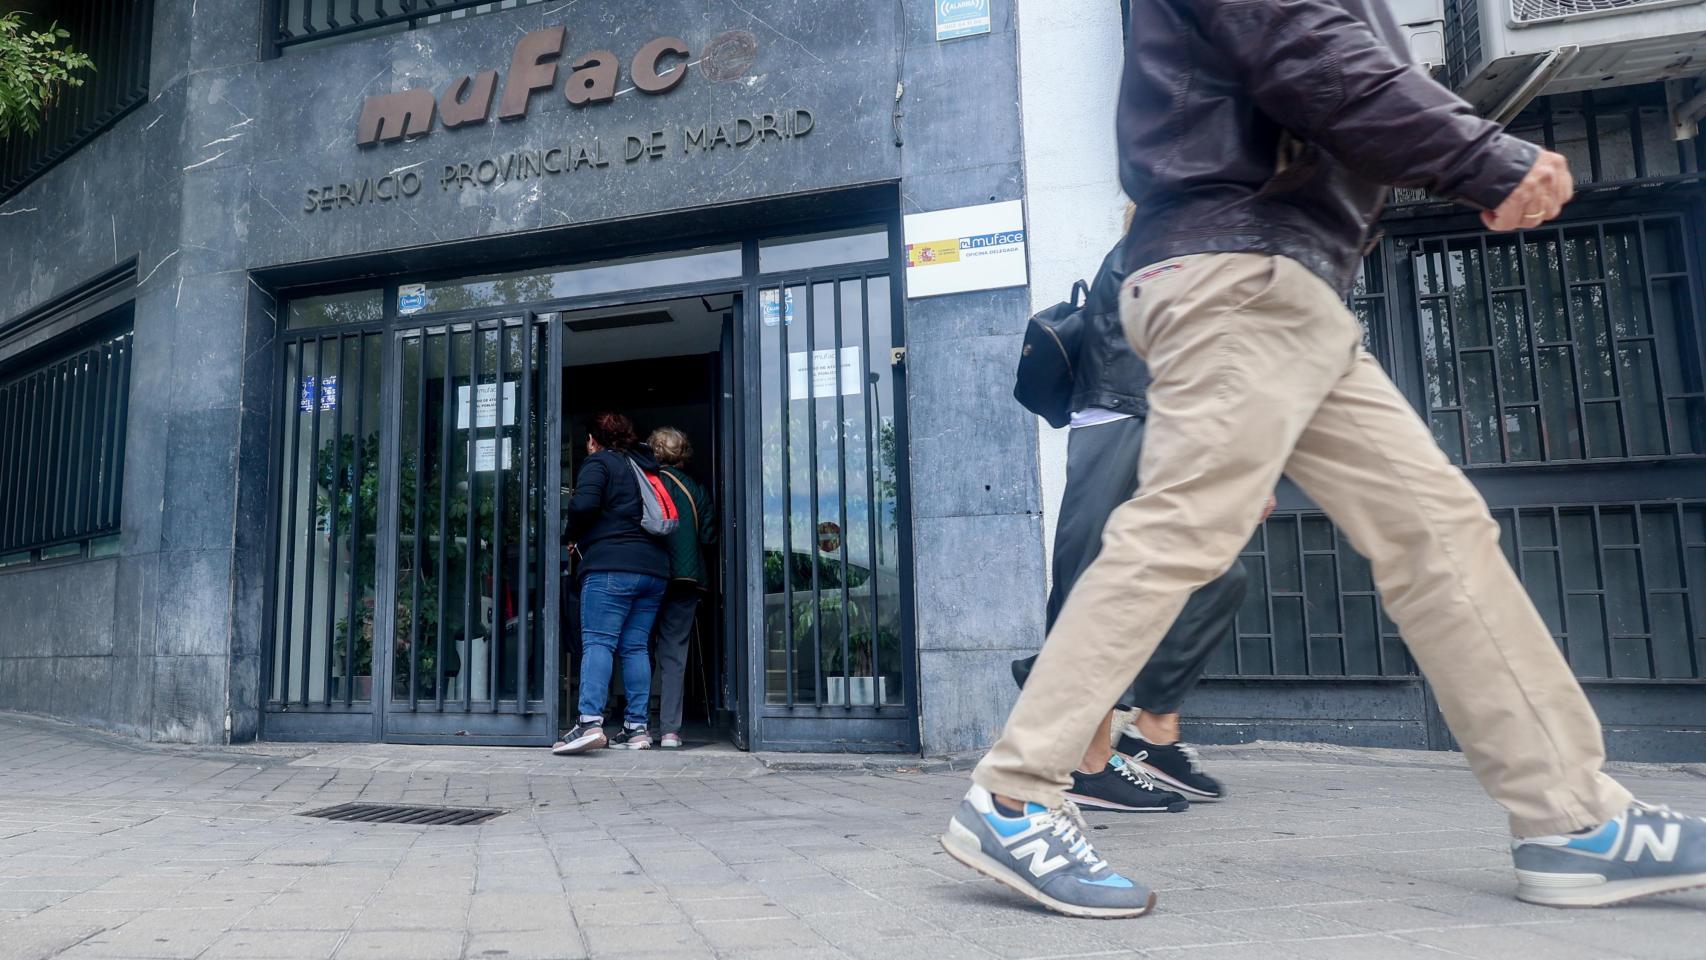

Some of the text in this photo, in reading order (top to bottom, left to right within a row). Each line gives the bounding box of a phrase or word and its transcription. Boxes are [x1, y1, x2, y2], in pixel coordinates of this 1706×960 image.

[304, 109, 816, 213] SERVICIO PROVINCIAL DE MADRID
[972, 233, 1023, 247] muface
[1010, 838, 1069, 878] N
[1624, 823, 1681, 862] N
